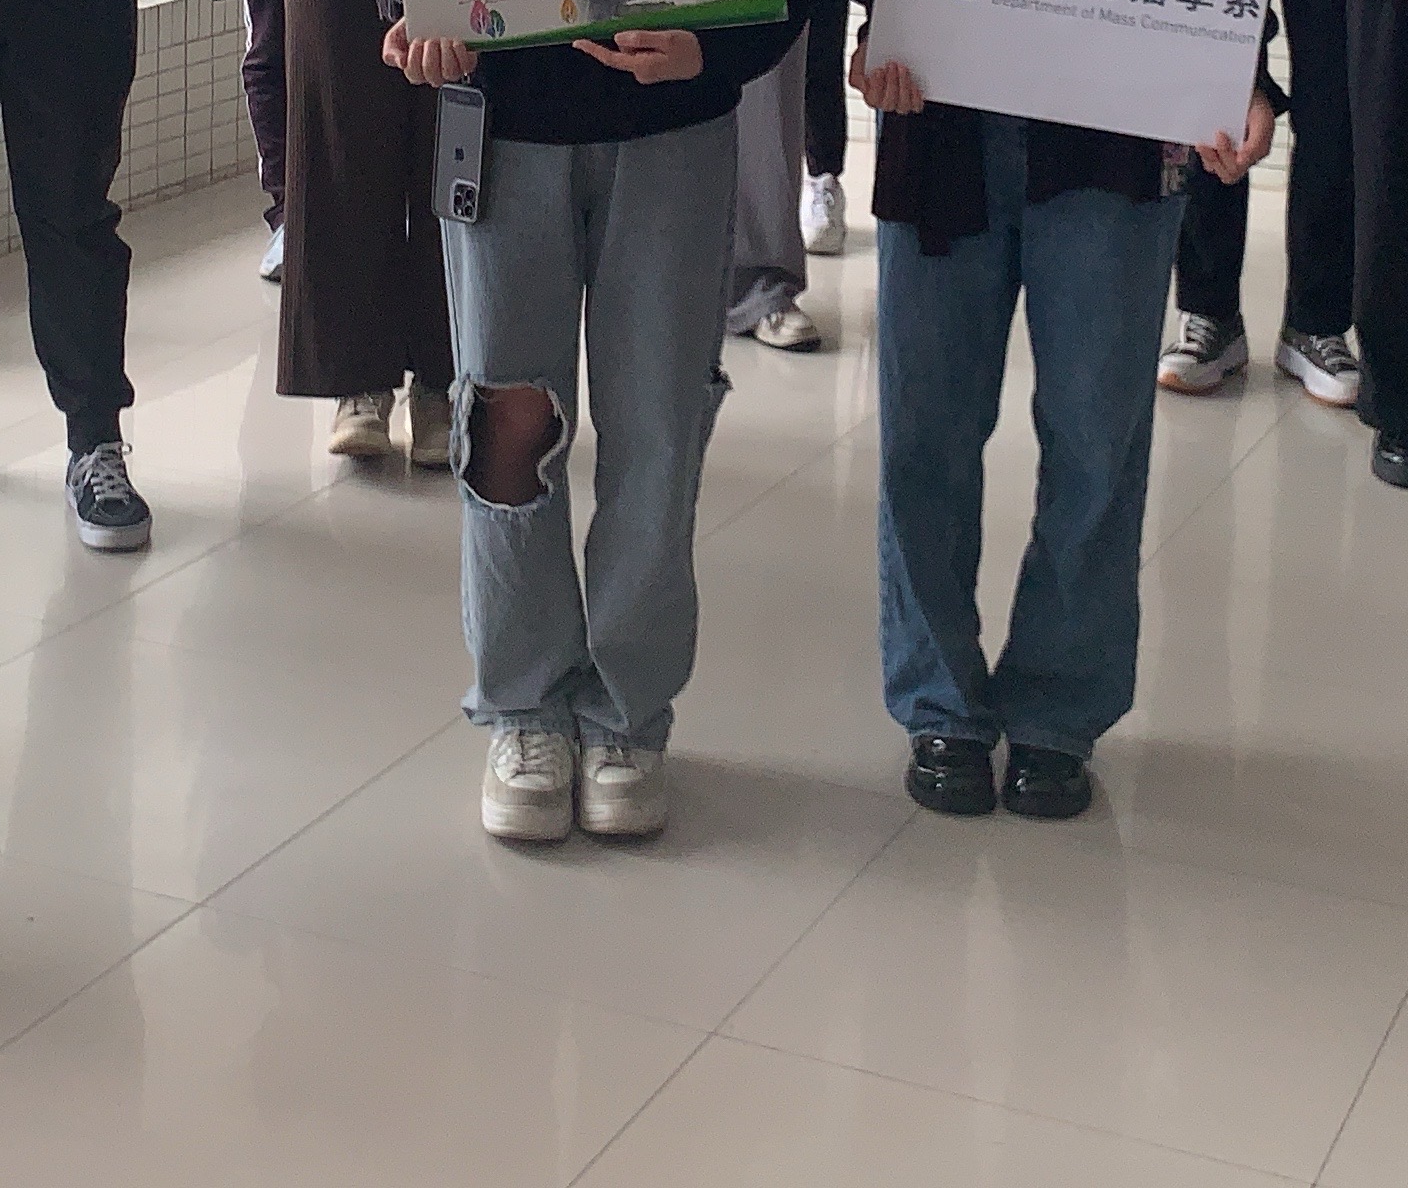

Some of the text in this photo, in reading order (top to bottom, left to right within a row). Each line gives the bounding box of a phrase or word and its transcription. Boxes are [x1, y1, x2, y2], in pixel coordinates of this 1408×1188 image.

[1081, 7, 1095, 20] of
[1099, 7, 1136, 27] Mass
[1140, 14, 1257, 45] Communication
